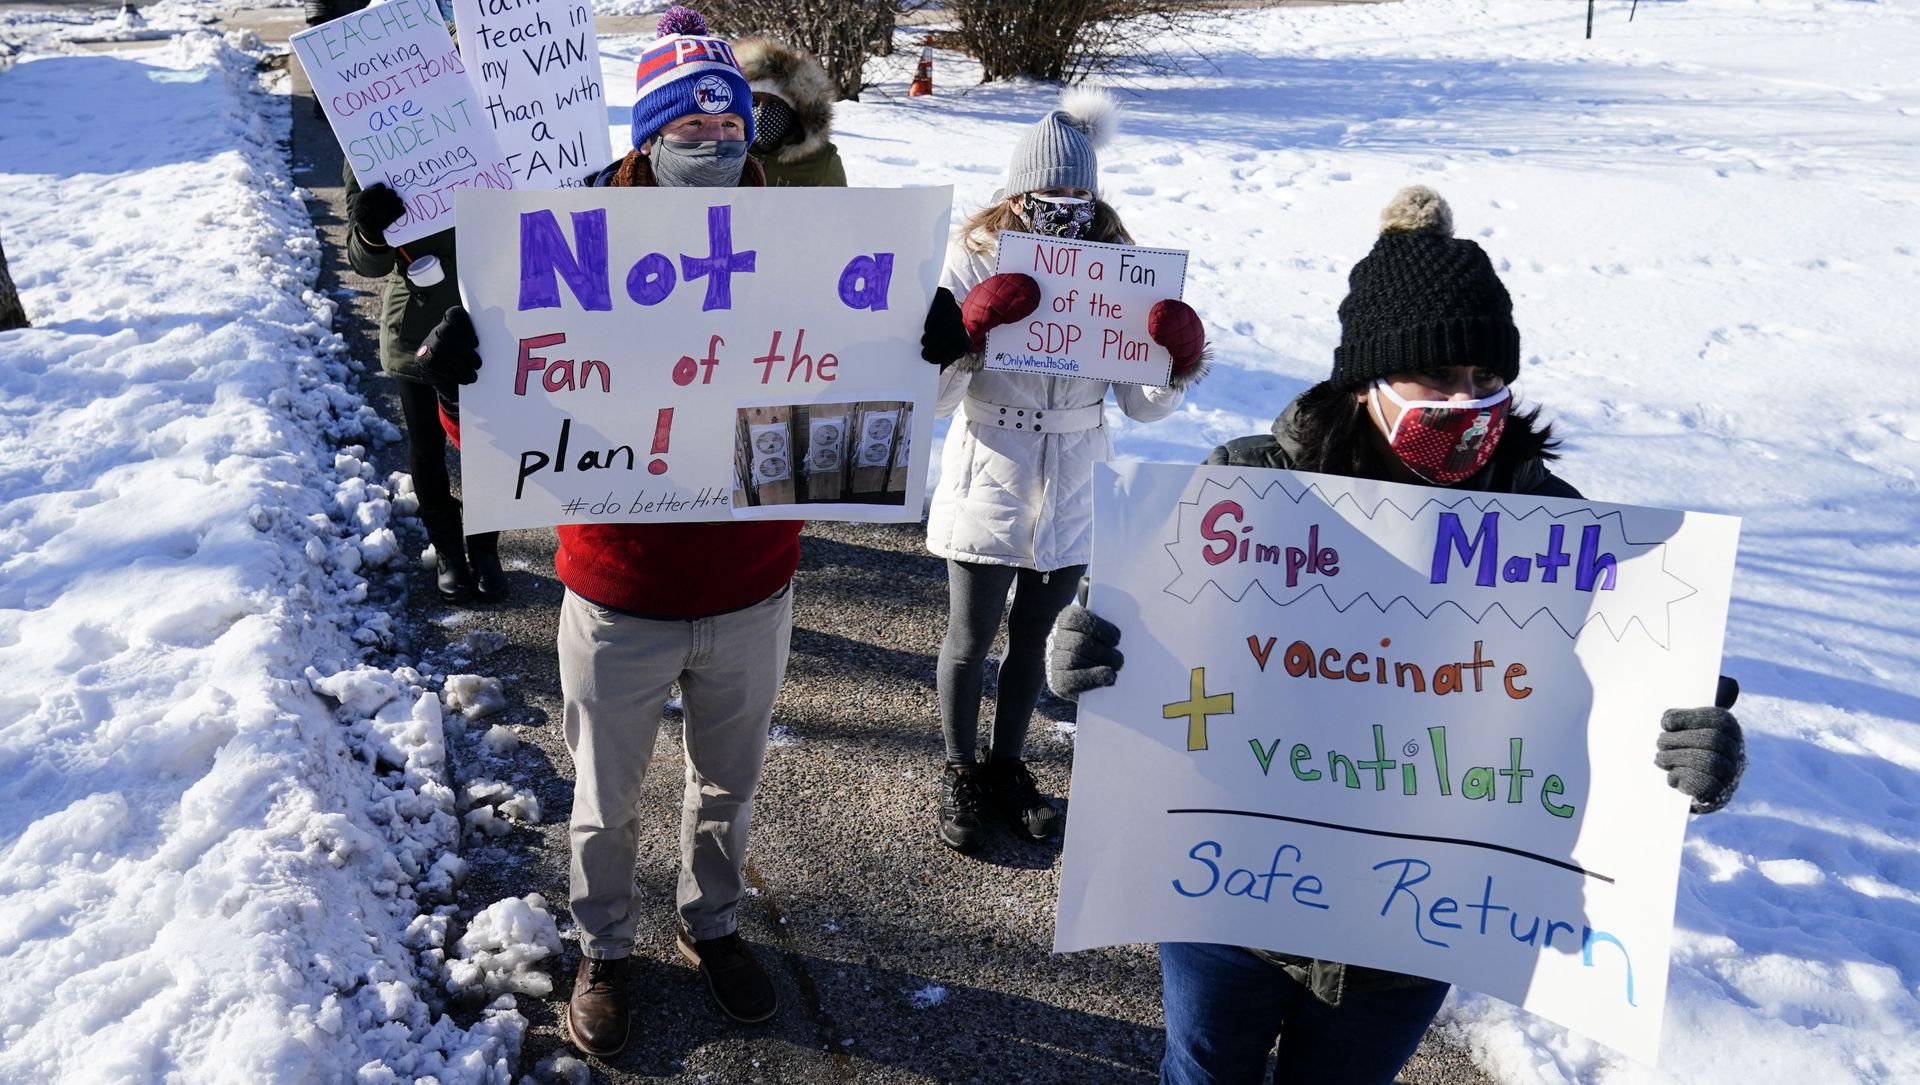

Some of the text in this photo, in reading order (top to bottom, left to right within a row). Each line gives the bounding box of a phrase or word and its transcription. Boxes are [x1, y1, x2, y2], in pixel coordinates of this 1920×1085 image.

[294, 0, 442, 68] TEACHER
[476, 12, 552, 50] teach
[569, 4, 588, 28] in
[332, 50, 466, 116] CONDITIONS
[337, 43, 429, 83] working
[481, 59, 509, 90] my
[369, 100, 423, 132] are
[485, 75, 600, 130] than with
[348, 98, 472, 172] STUDENT
[505, 130, 588, 181] FAN!
[531, 121, 556, 142] a
[384, 146, 477, 188] learning
[517, 204, 895, 313] Not a
[1034, 244, 1156, 287] NOT a Fan
[1052, 289, 1123, 319] of the
[514, 328, 839, 397] Fan of the
[1026, 320, 1149, 363] SDP Plan
[514, 407, 676, 500] plan!
[1200, 499, 1618, 593] Simple Math
[1246, 634, 1533, 700] vaccinate
[1248, 723, 1575, 820] ventilate
[1171, 841, 1638, 1008] Safe Return
